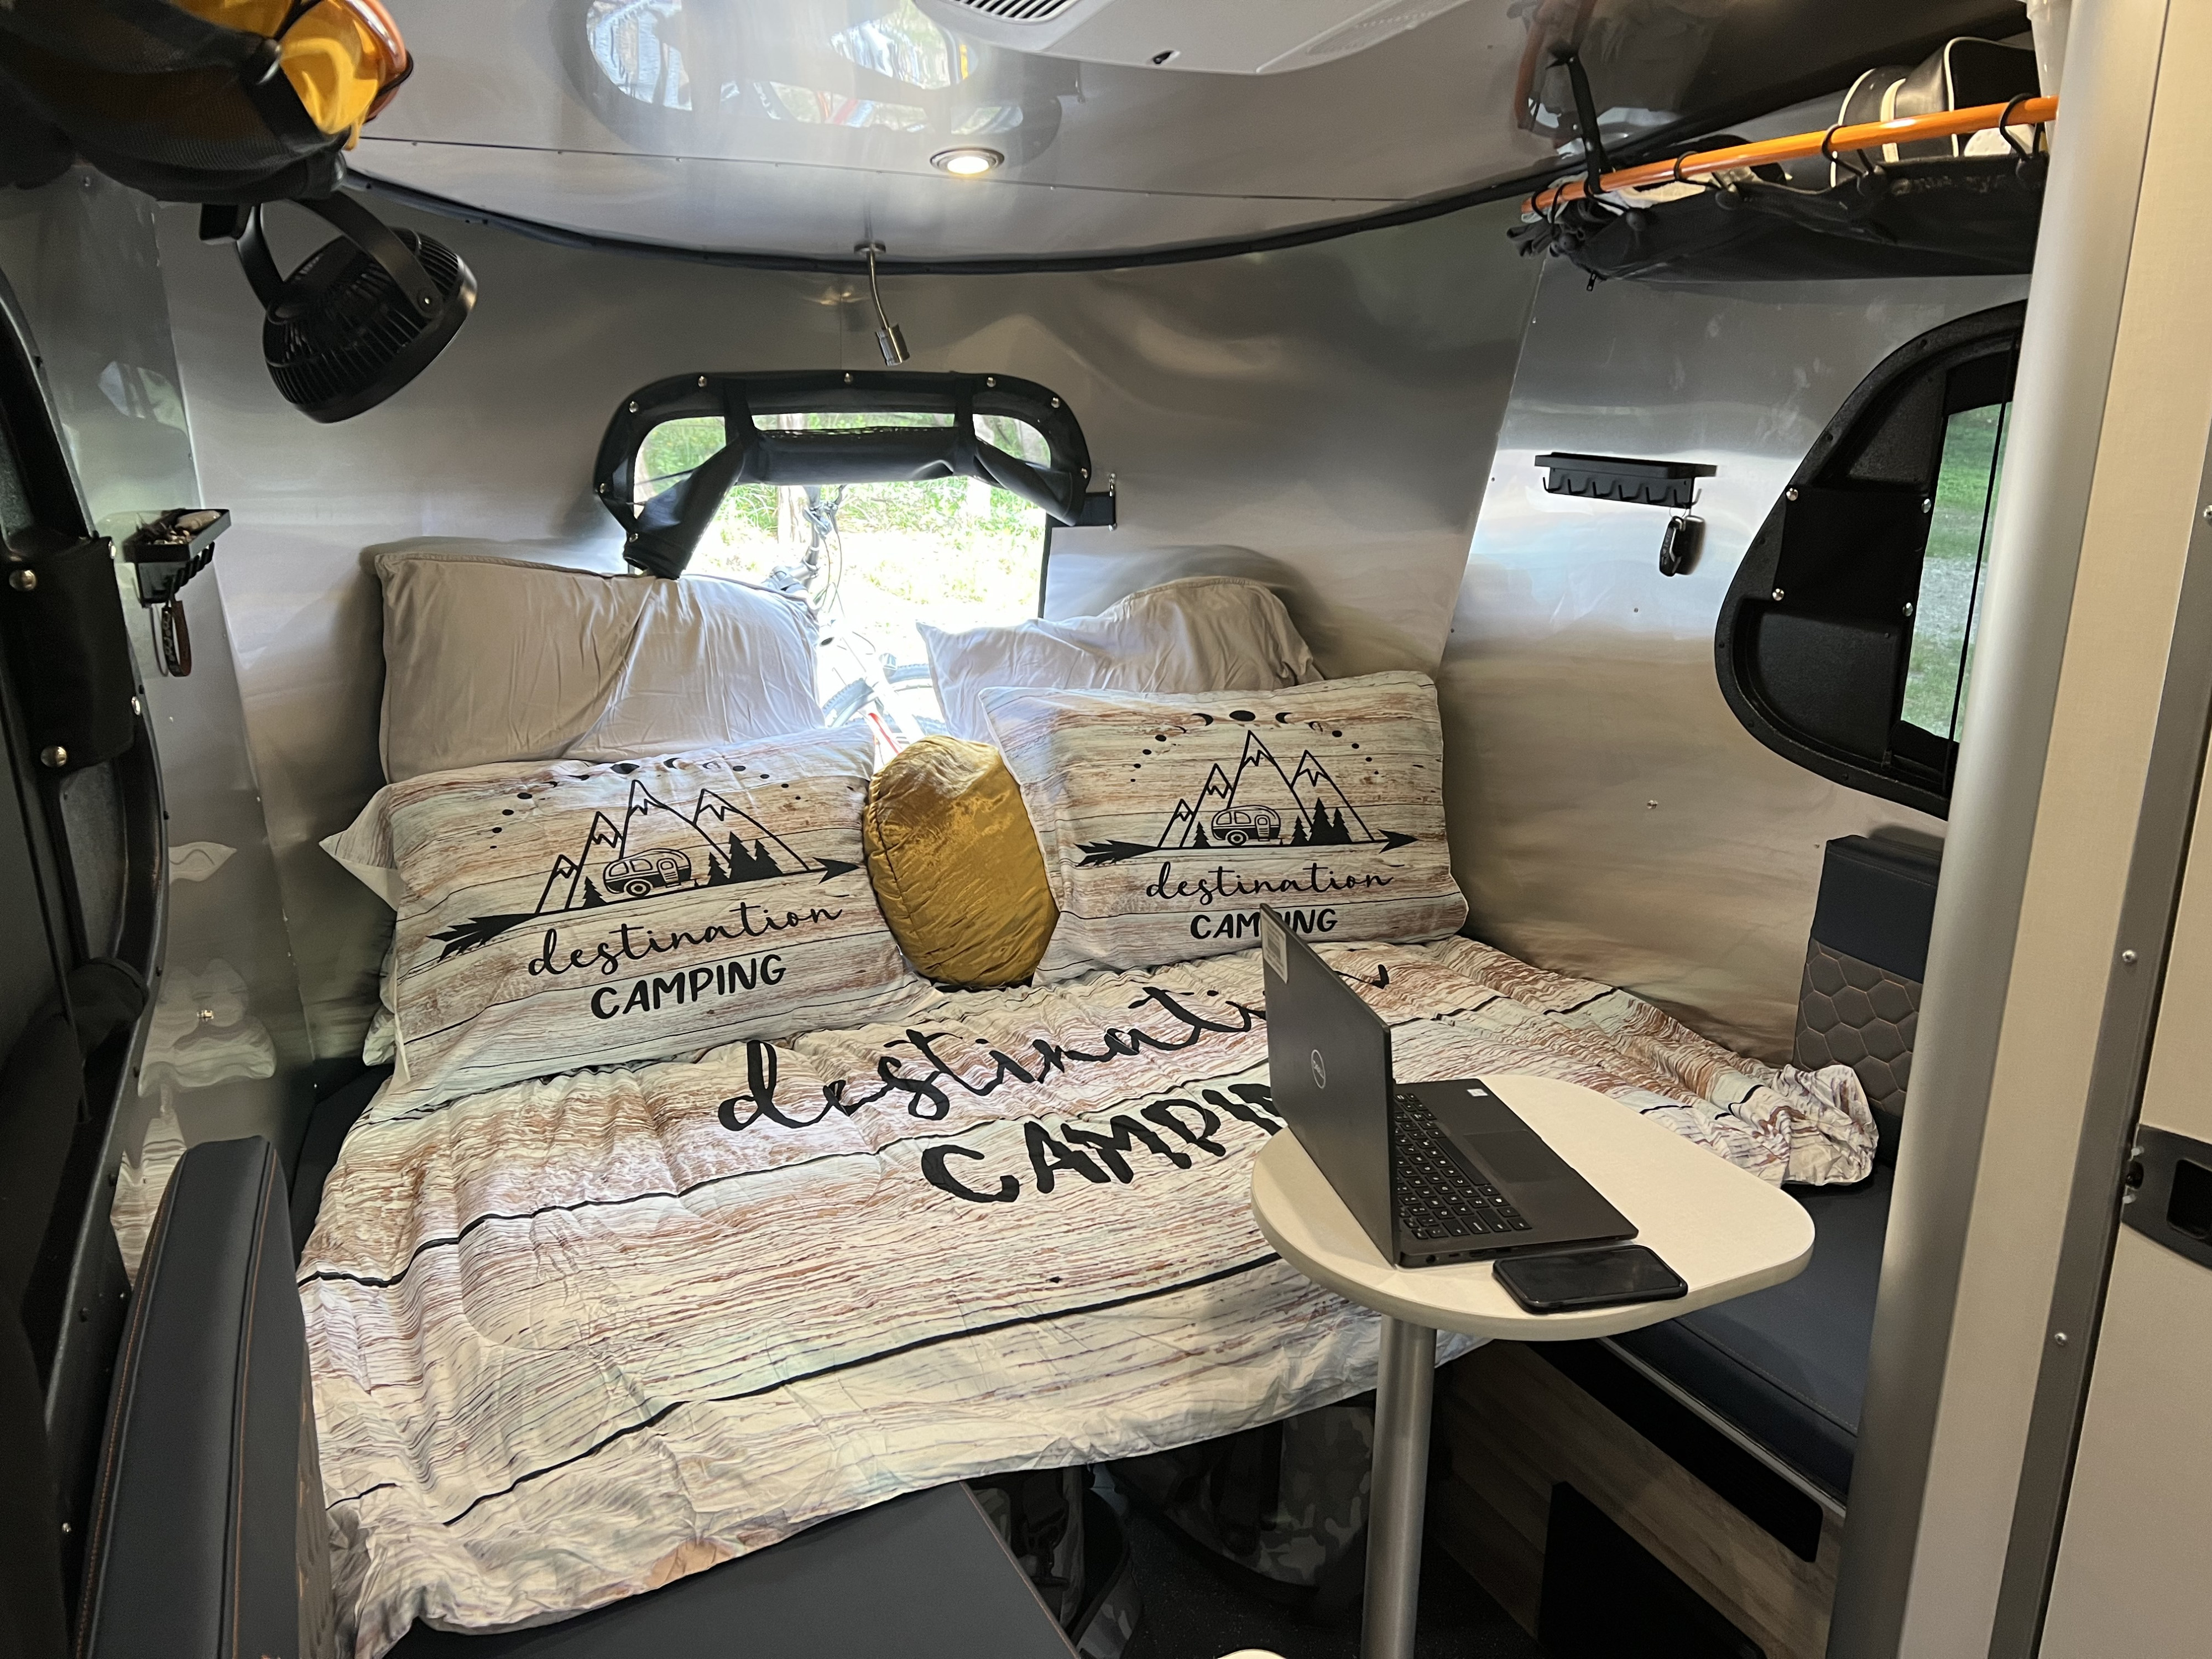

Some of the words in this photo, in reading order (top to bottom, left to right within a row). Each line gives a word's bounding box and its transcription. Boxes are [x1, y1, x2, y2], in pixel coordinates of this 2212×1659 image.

[1146, 861, 1394, 906] destination
[528, 901, 843, 977] destination
[1190, 908, 1338, 940] CAMING
[591, 954, 787, 1019] CAMPING
[718, 964, 1389, 1131] destinati
[921, 1083, 1289, 1203] CAMPI
